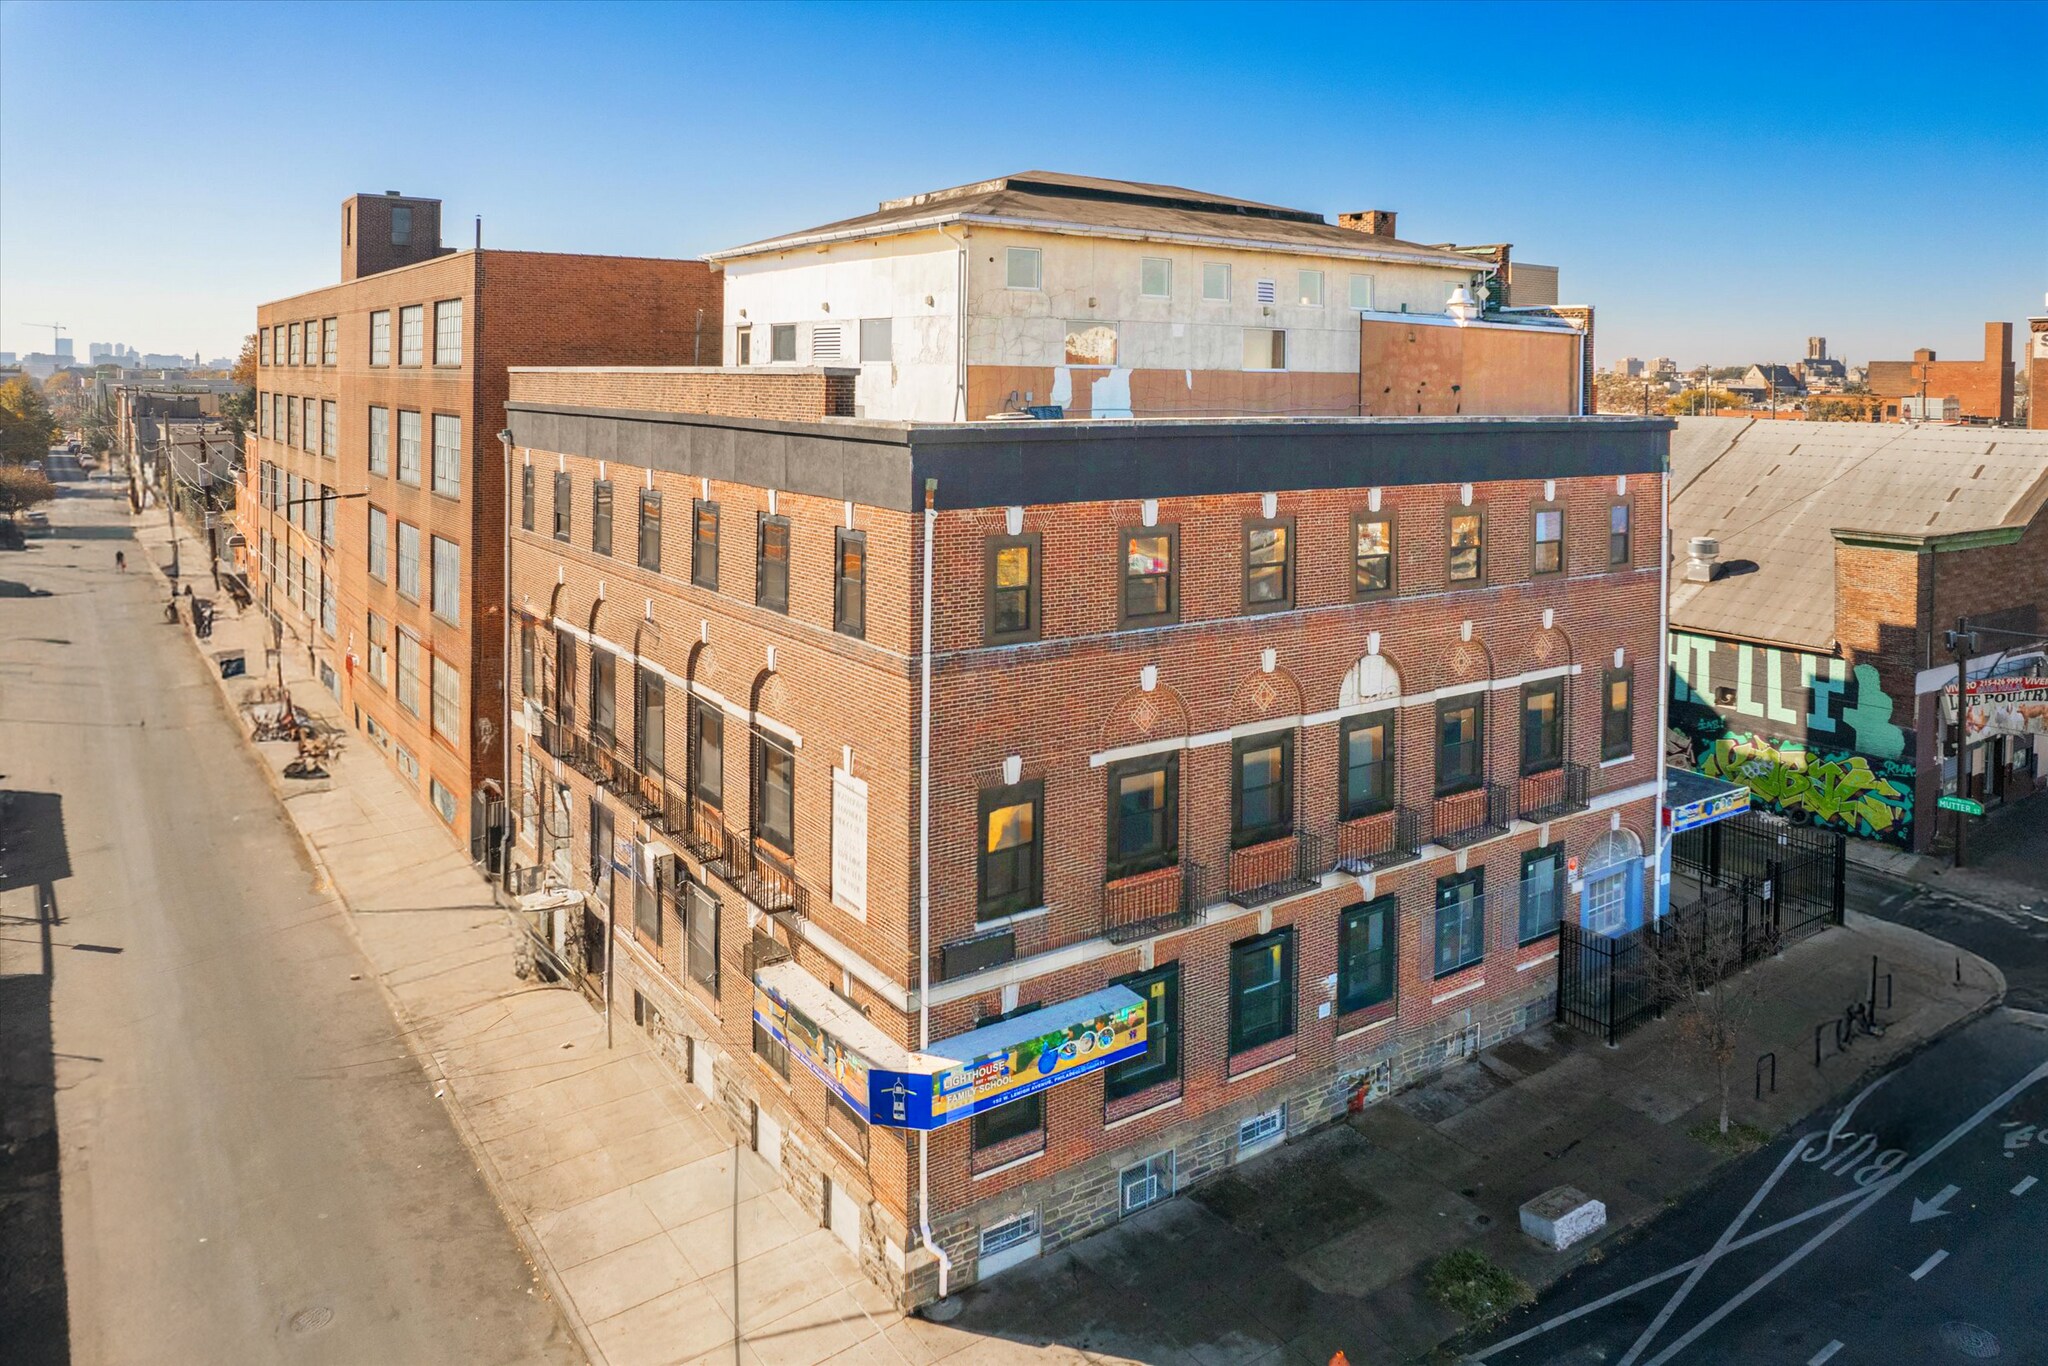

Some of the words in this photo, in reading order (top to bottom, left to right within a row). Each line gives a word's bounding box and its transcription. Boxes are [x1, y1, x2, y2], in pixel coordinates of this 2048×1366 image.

[1945, 682, 1977, 693] VIVRO
[1948, 694, 1981, 710] LVE
[1940, 800, 1971, 812] MUTTER
[943, 1061, 1006, 1090] LIGHTHOUSE
[947, 1086, 978, 1104] FAMILY
[979, 1076, 1014, 1093] SCHOOL
[1801, 1131, 1909, 1186] BUS
